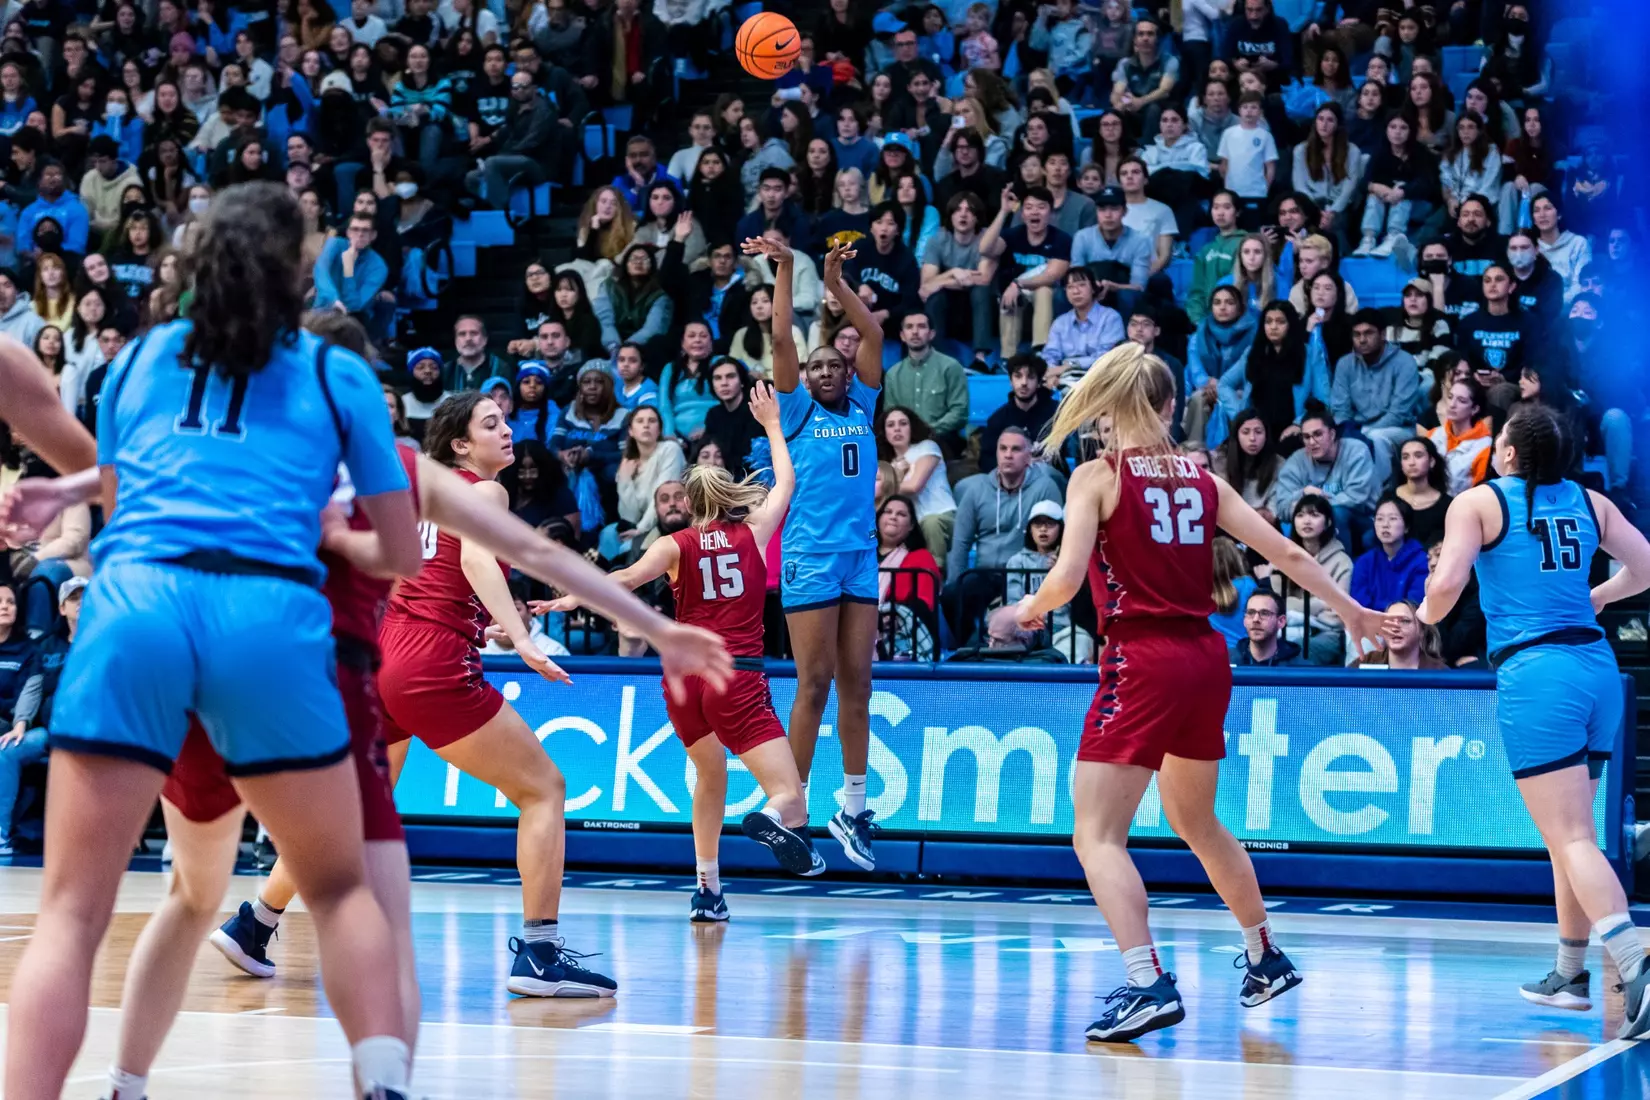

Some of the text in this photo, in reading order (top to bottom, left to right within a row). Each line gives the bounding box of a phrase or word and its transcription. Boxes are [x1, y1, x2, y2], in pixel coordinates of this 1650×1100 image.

[173, 352, 254, 443] 11
[842, 442, 860, 478] 0
[1143, 486, 1204, 545] 32
[417, 520, 439, 560] 0
[1532, 516, 1582, 572] 15
[698, 553, 744, 600] 15
[583, 821, 640, 829] DAKTRONICS
[1240, 841, 1289, 850] KTRONICS
